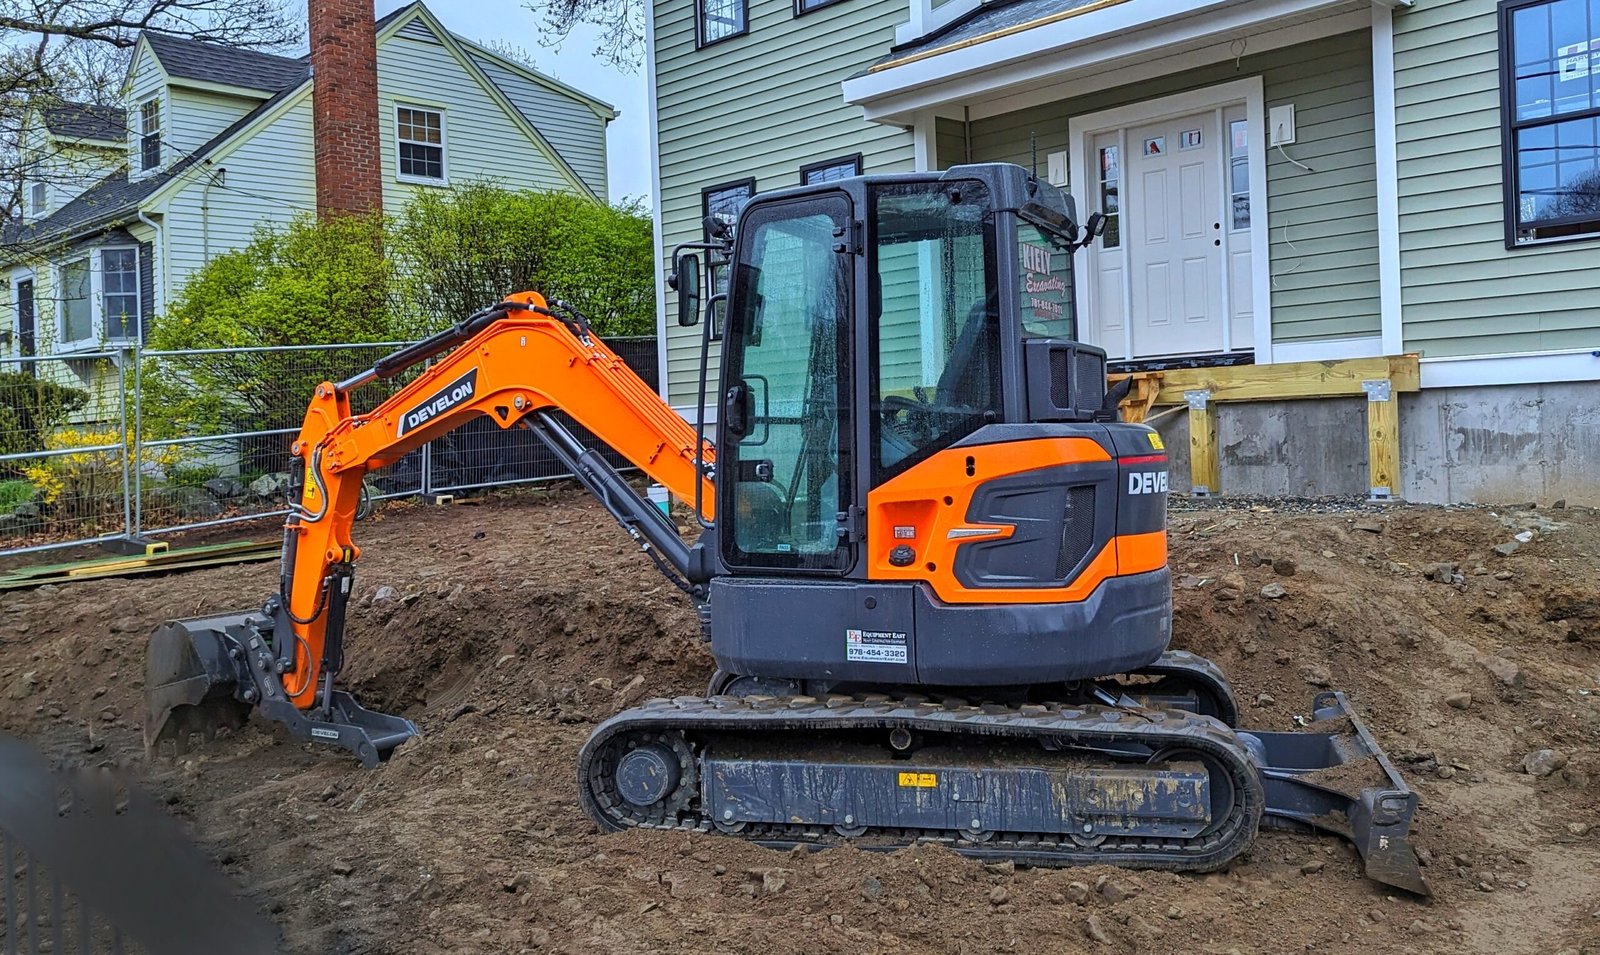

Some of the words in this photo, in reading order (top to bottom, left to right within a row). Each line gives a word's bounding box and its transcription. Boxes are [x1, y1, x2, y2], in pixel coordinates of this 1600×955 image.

[1566, 52, 1600, 63] HARVY
[1023, 243, 1051, 275] KIELY
[1026, 273, 1066, 297] Excavating
[408, 381, 473, 428] DEVELON
[862, 631, 891, 639] EQUIPMENT
